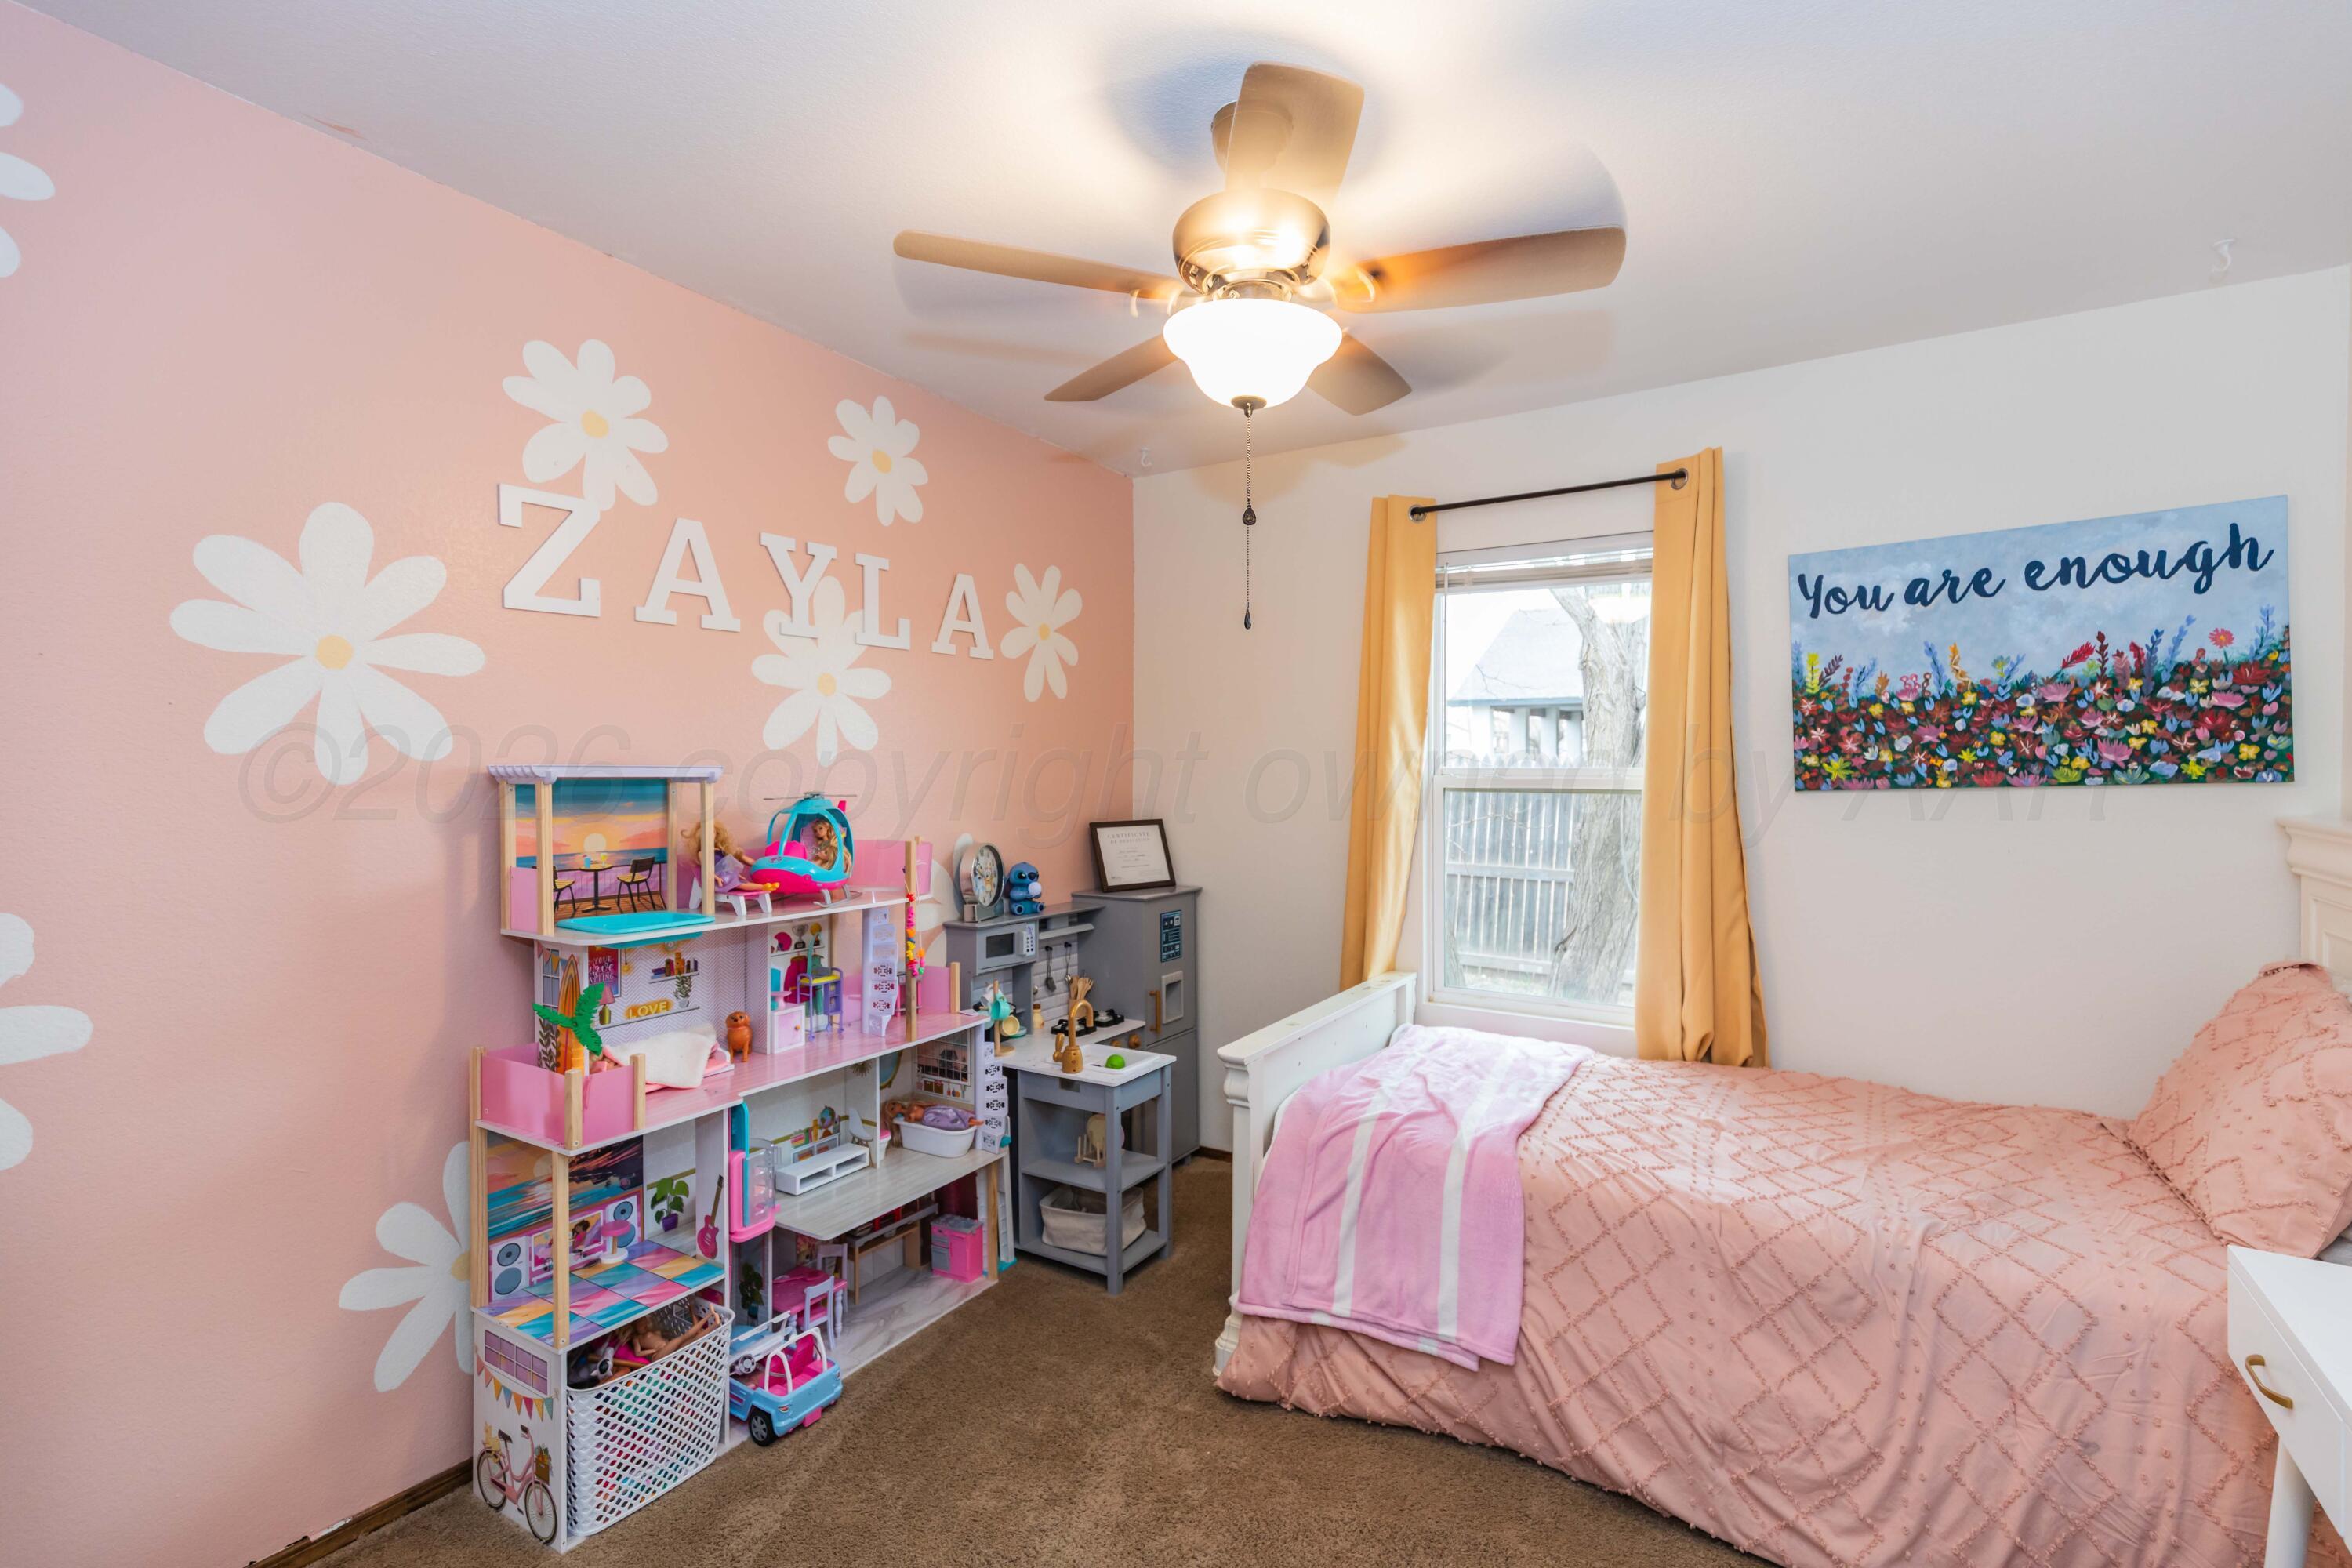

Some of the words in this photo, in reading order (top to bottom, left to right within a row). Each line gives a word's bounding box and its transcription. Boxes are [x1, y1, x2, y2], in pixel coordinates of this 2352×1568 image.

[497, 483, 994, 660] ZAYLA
[1798, 573, 1895, 619] You
[1904, 566, 2006, 608] are
[2024, 523, 2274, 596] enough
[629, 1001, 667, 1019] LOVE
